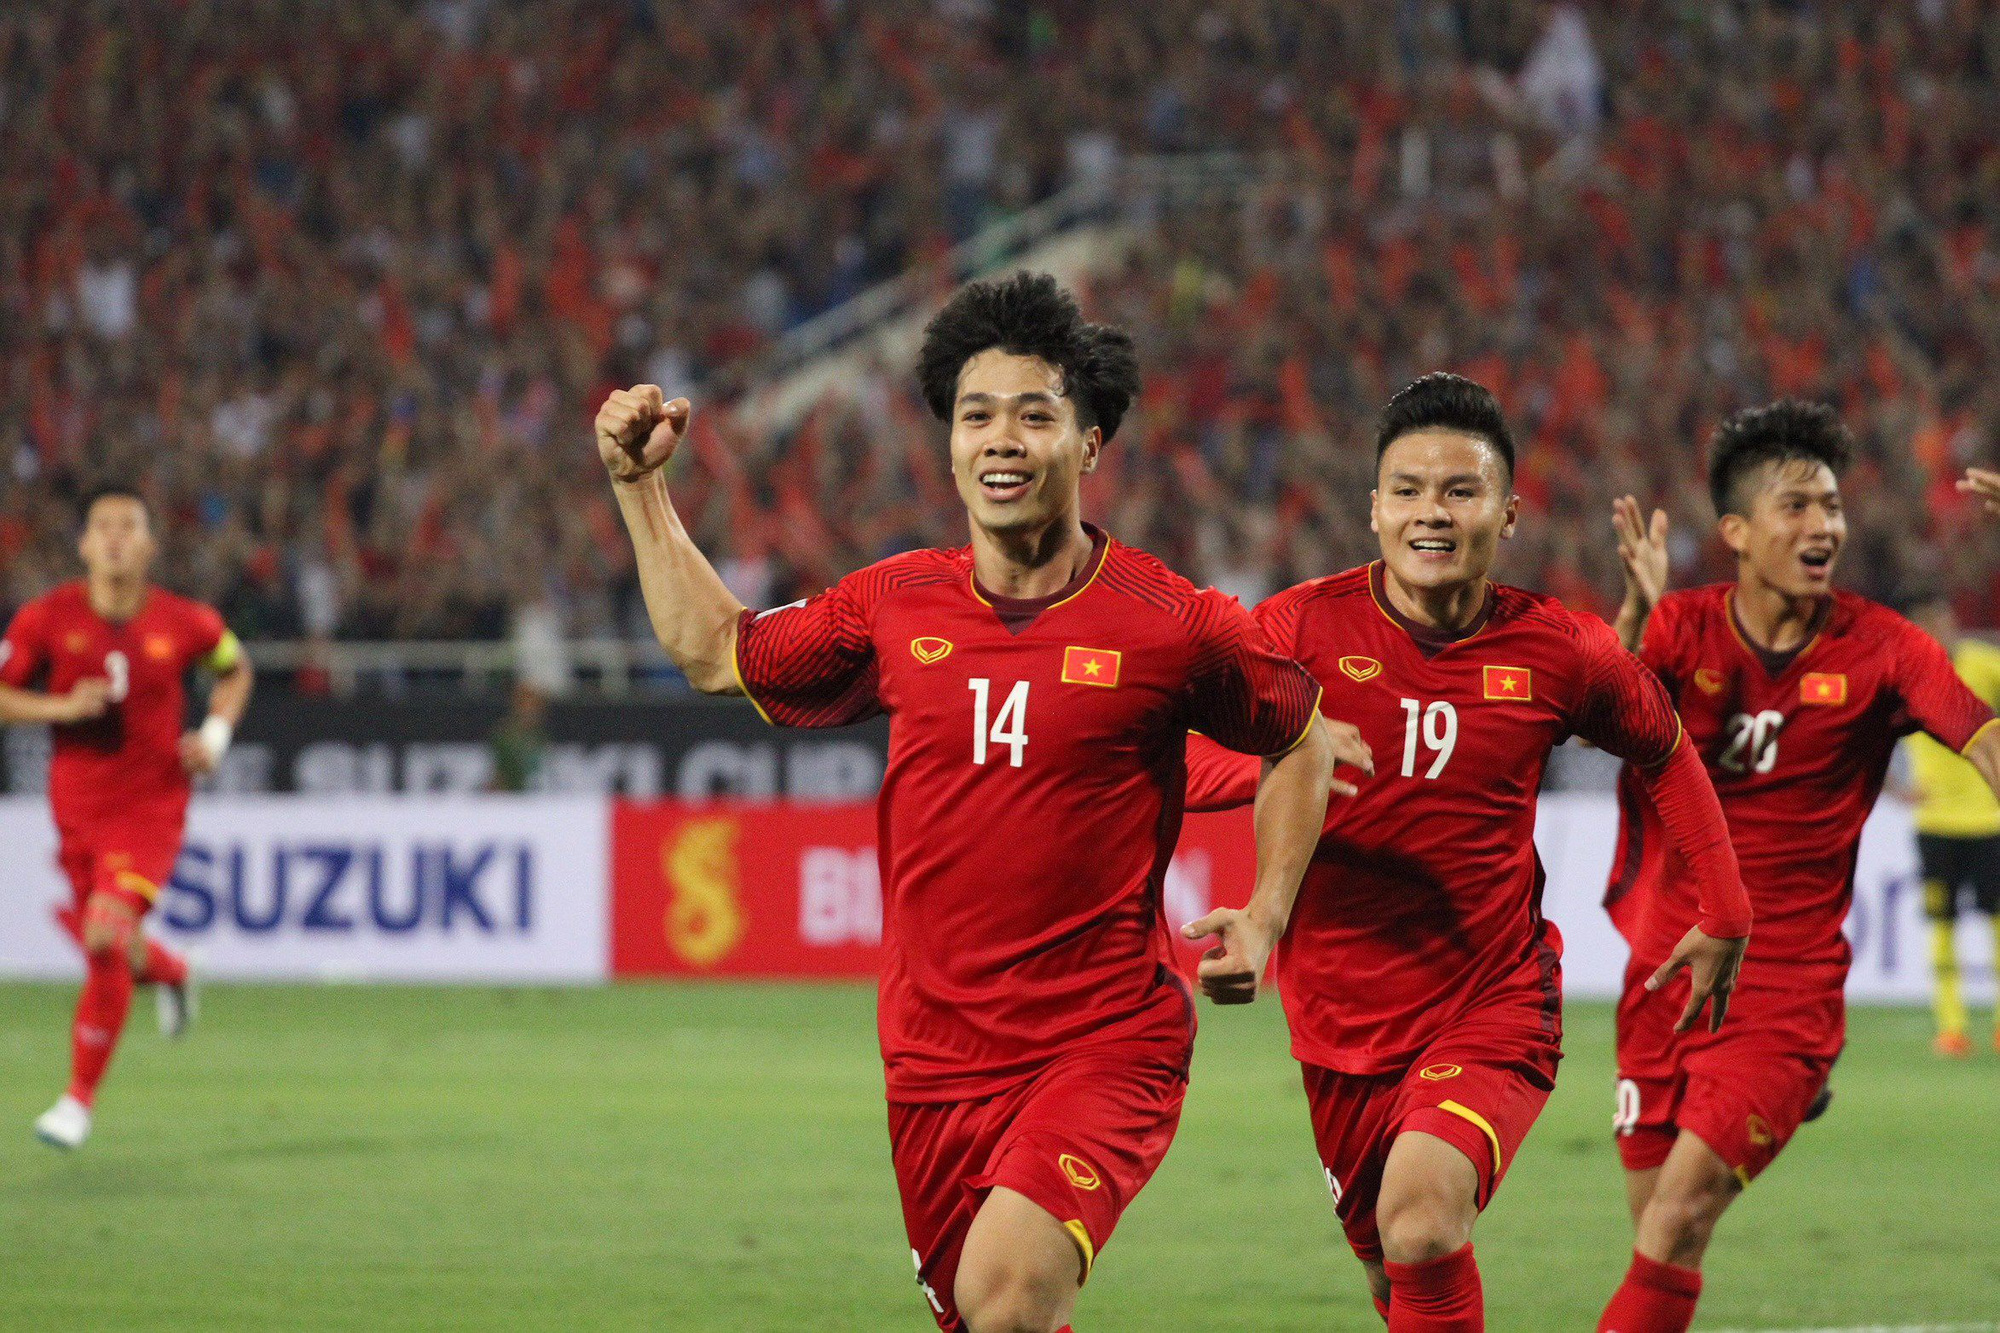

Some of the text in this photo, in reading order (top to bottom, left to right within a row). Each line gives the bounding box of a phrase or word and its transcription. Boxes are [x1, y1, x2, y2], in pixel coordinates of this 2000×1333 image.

[968, 677, 1030, 767] 14
[1400, 698, 1458, 780] 19
[1721, 710, 1784, 774] 20
[163, 842, 533, 936] SUZUKI
[1613, 1079, 1641, 1136] 0
